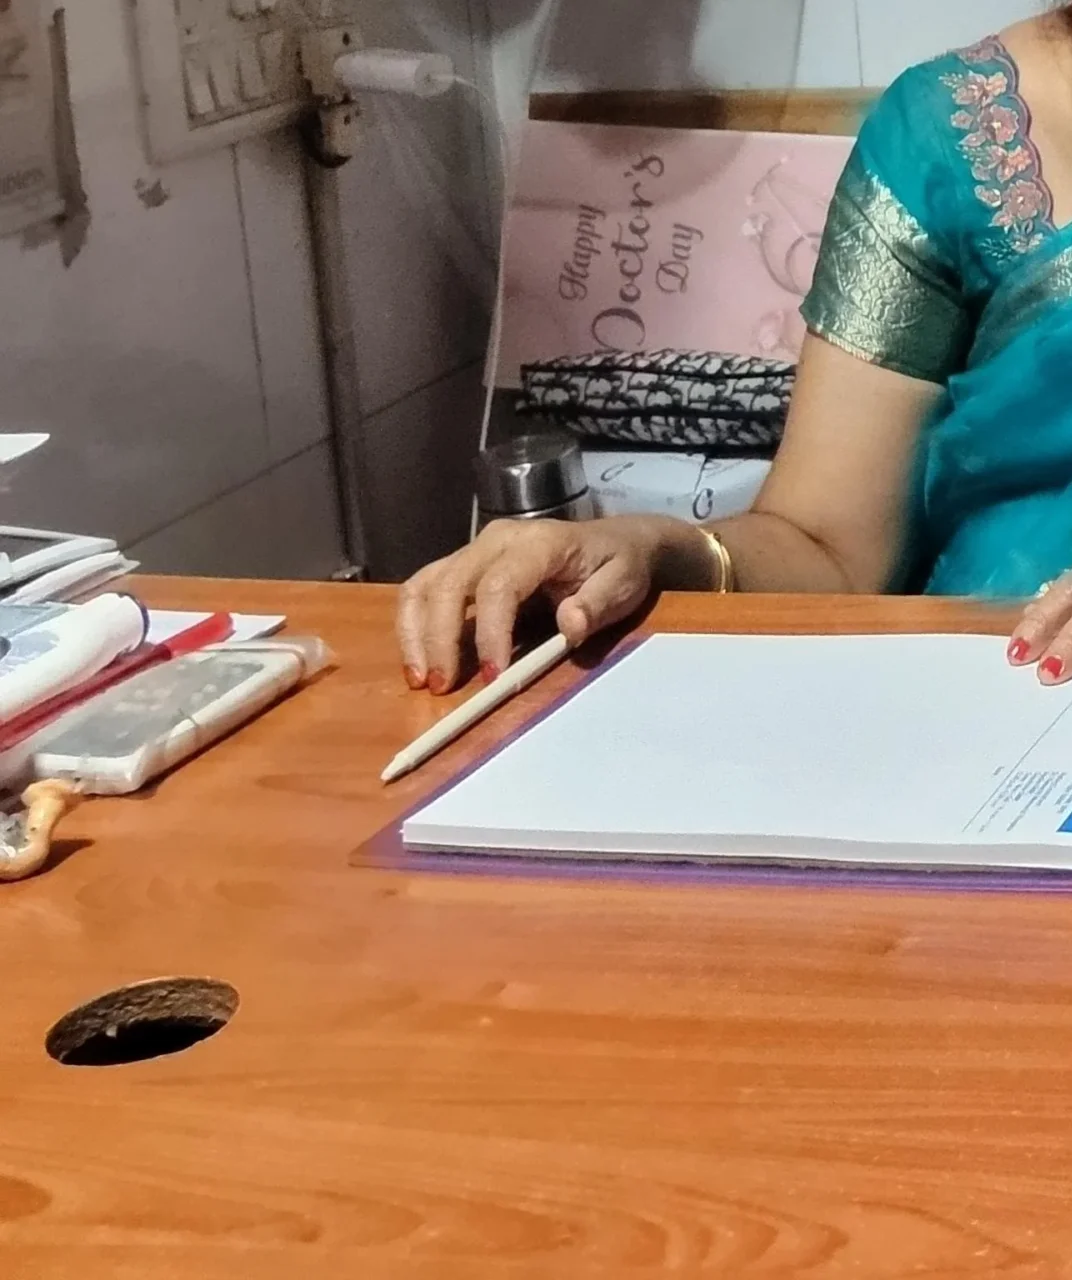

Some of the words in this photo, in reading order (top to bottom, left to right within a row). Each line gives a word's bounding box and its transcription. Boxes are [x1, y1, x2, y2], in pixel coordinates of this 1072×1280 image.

[558, 204, 607, 300] Happy
[591, 155, 665, 355] Doctor's
[655, 223, 704, 294] Day
